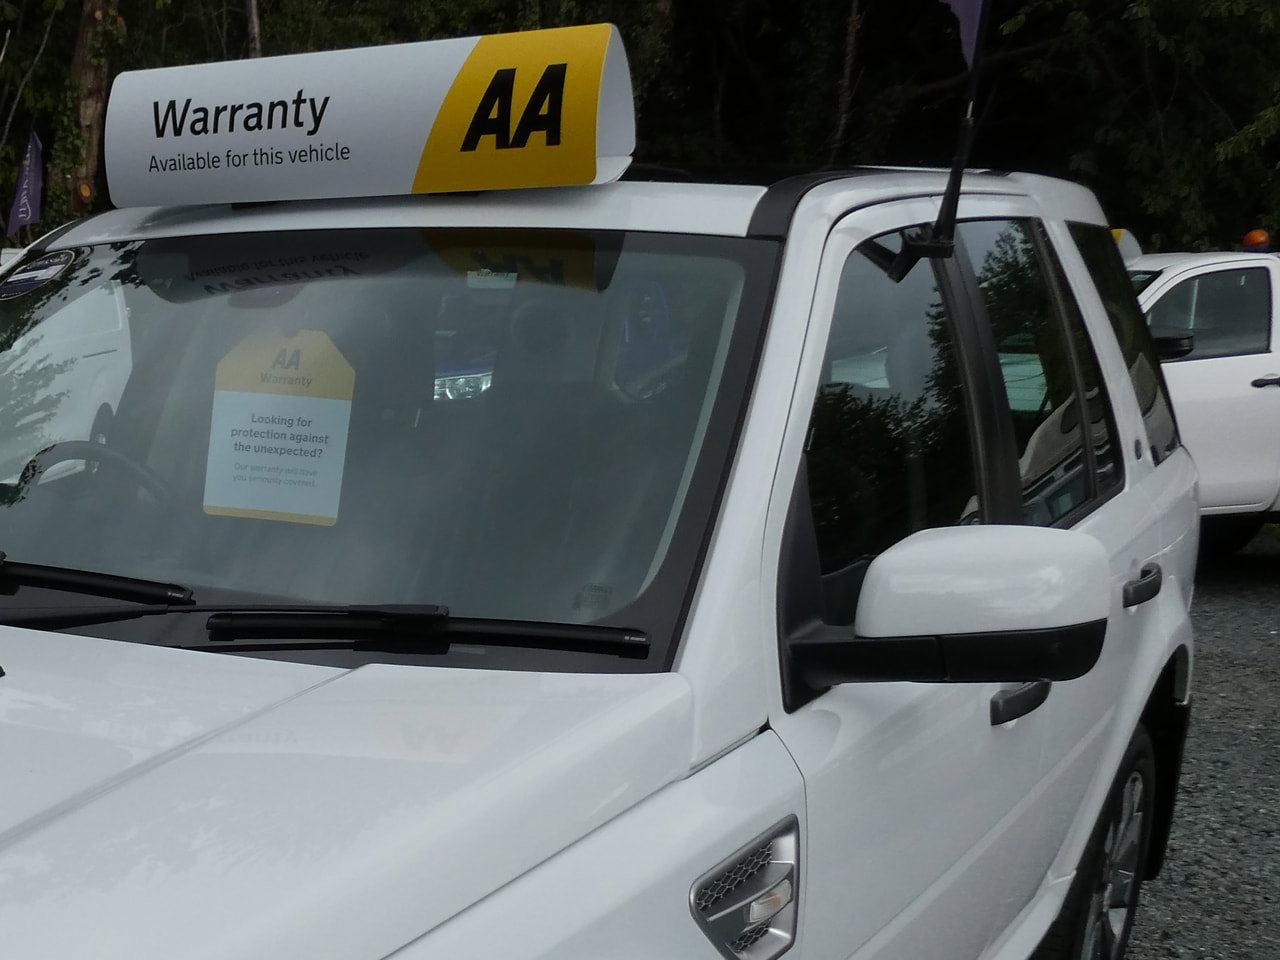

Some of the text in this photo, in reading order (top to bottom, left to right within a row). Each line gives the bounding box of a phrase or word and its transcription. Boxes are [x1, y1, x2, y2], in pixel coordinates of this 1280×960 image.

[153, 88, 330, 138] Warranty
[460, 63, 567, 152] AA
[149, 142, 351, 173] Available for this vehicle
[271, 348, 301, 370] AA
[260, 371, 313, 389] Warranty
[251, 413, 312, 428] Looking for
[230, 428, 329, 444] protection against
[233, 441, 323, 458] the unexpected?
